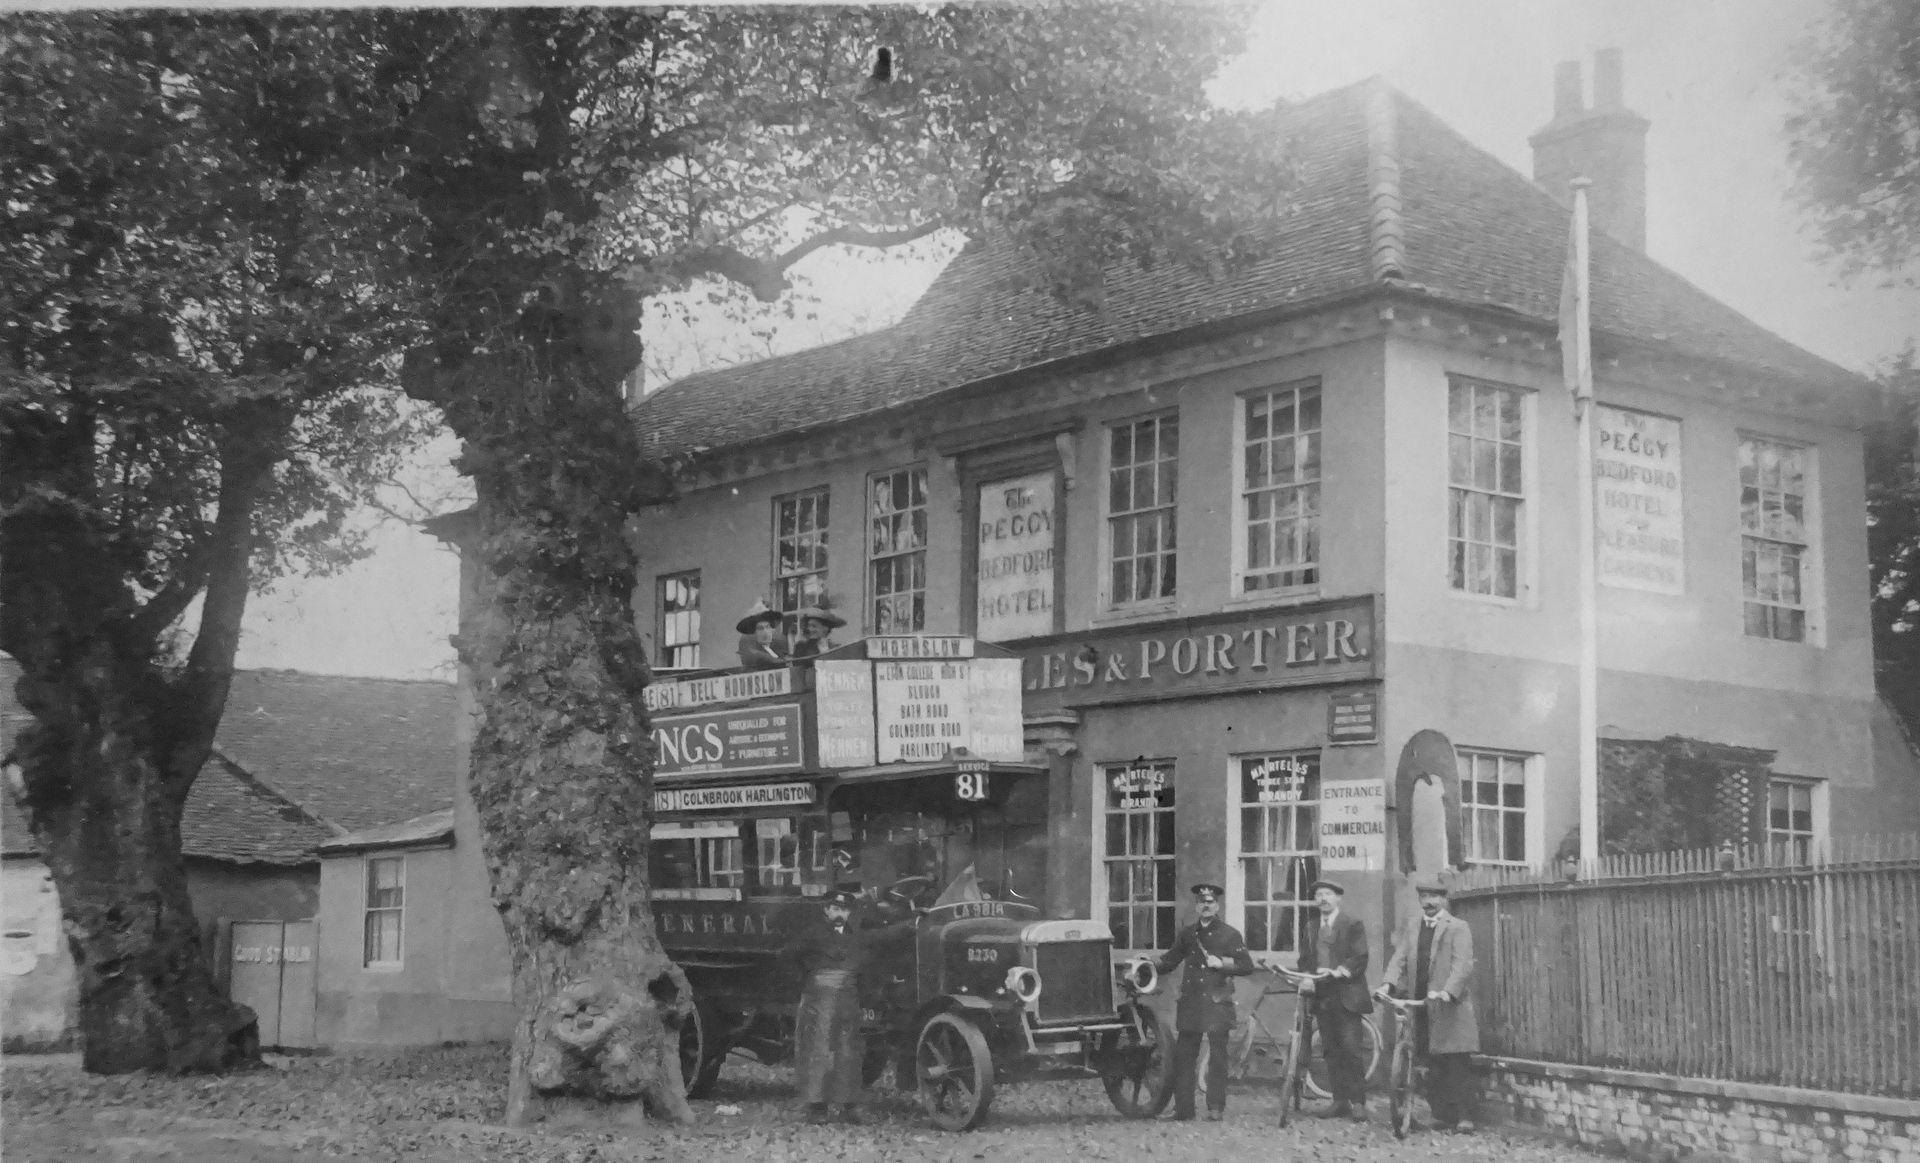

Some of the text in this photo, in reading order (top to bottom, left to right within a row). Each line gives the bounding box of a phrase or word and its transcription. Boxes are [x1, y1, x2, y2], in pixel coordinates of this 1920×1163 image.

[1600, 430, 1669, 459] PEGGY
[1597, 458, 1678, 490] BEDFORD
[1604, 489, 1665, 516] HOTEL
[982, 510, 1051, 544] PEGGY
[981, 548, 1053, 581] BEDFORD
[981, 588, 1051, 619] HOTEL
[880, 639, 960, 657] HOUNSLOW
[1104, 653, 1129, 682] &
[1140, 619, 1368, 680] PORTER.
[724, 671, 783, 698] HOUNSLOW
[901, 703, 948, 719] BATH ROAD
[889, 722, 961, 738] COLNBROOK ROAD
[650, 722, 724, 766] NGS
[683, 790, 743, 806] COLNBROOK
[744, 785, 811, 803] HARLINGTON
[958, 773, 985, 799] 81
[1258, 790, 1303, 802] BRANDY
[1323, 785, 1383, 799] ENTRANCE
[1344, 804, 1358, 815] TO
[1321, 821, 1384, 836] COMMERCIAL
[1321, 845, 1356, 859] ROOM
[661, 913, 772, 935] ENERAL
